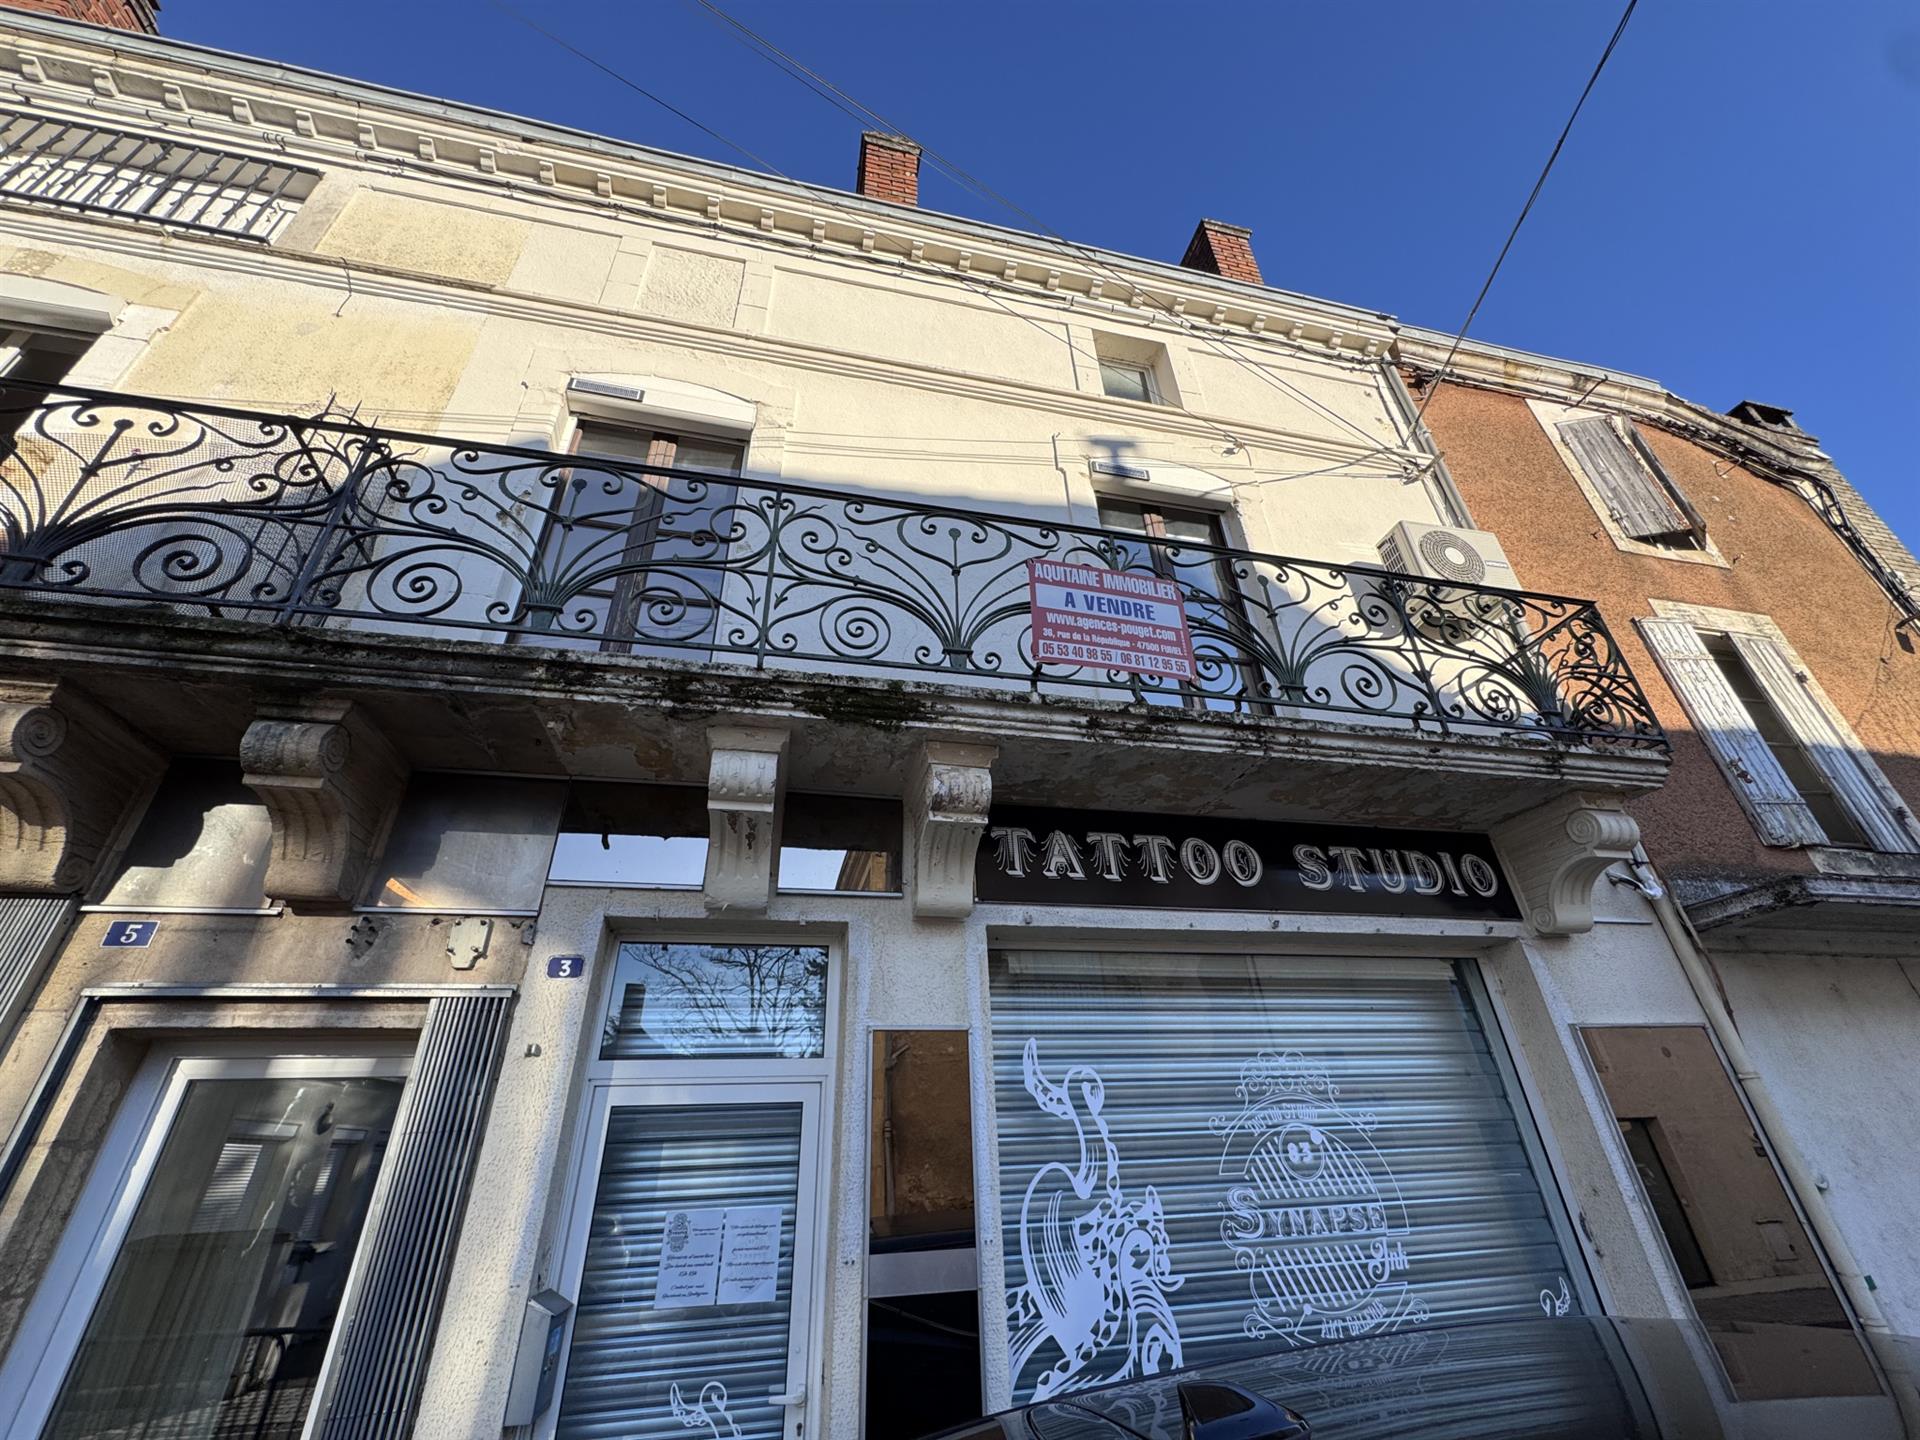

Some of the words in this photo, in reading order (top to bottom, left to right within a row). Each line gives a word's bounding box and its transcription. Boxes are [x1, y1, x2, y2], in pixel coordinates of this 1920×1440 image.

[1035, 563, 1100, 587] AQUITAINE
[1103, 573, 1177, 600] IMMOBILIER
[1064, 591, 1076, 609] A
[1083, 594, 1156, 621] VENDRE
[1046, 612, 1177, 641] www.agences-pouget.com
[1057, 631, 1071, 639] rue
[1072, 632, 1081, 640] de
[1042, 642, 1054, 655] 05
[1057, 644, 1069, 656] 53
[1072, 646, 1083, 658] 40
[1086, 648, 1098, 660] 98
[1101, 650, 1112, 661] 55
[1121, 652, 1132, 665] 06
[1134, 654, 1145, 666] 81
[1148, 656, 1159, 668] 12
[1161, 658, 1173, 671] 95
[1175, 660, 1186, 673] 55
[990, 826, 1264, 887] TATTOO
[1293, 843, 1499, 897] STUDIO
[120, 924, 143, 943] 5
[559, 960, 572, 976] 3
[1368, 1236, 1410, 1282] Ink
